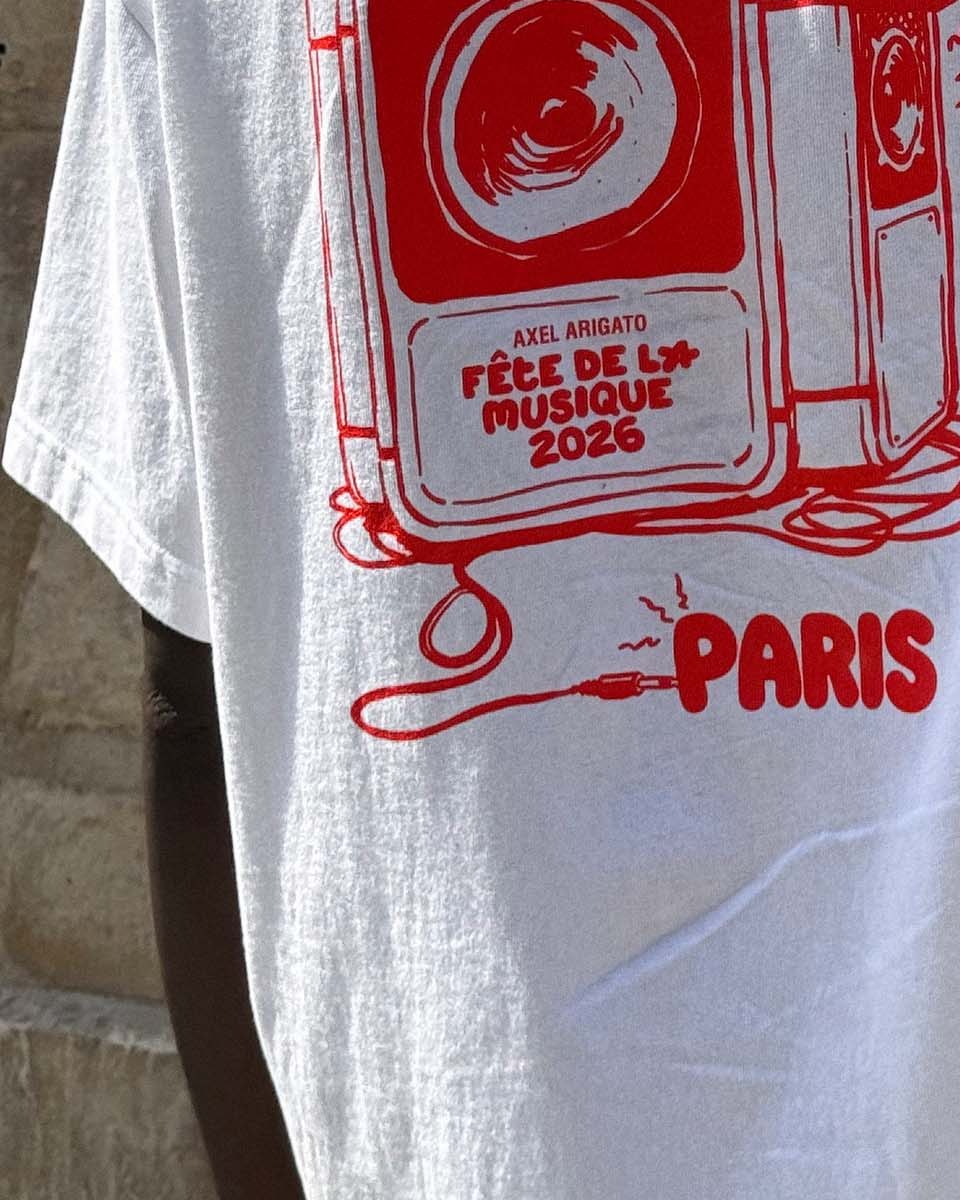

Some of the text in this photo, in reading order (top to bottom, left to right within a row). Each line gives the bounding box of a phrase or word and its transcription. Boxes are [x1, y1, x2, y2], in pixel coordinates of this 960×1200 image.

[514, 314, 647, 348] AXEL ARIGATO
[574, 345, 627, 381] DE
[528, 416, 645, 469] 2026
[673, 609, 937, 713] PARIS
